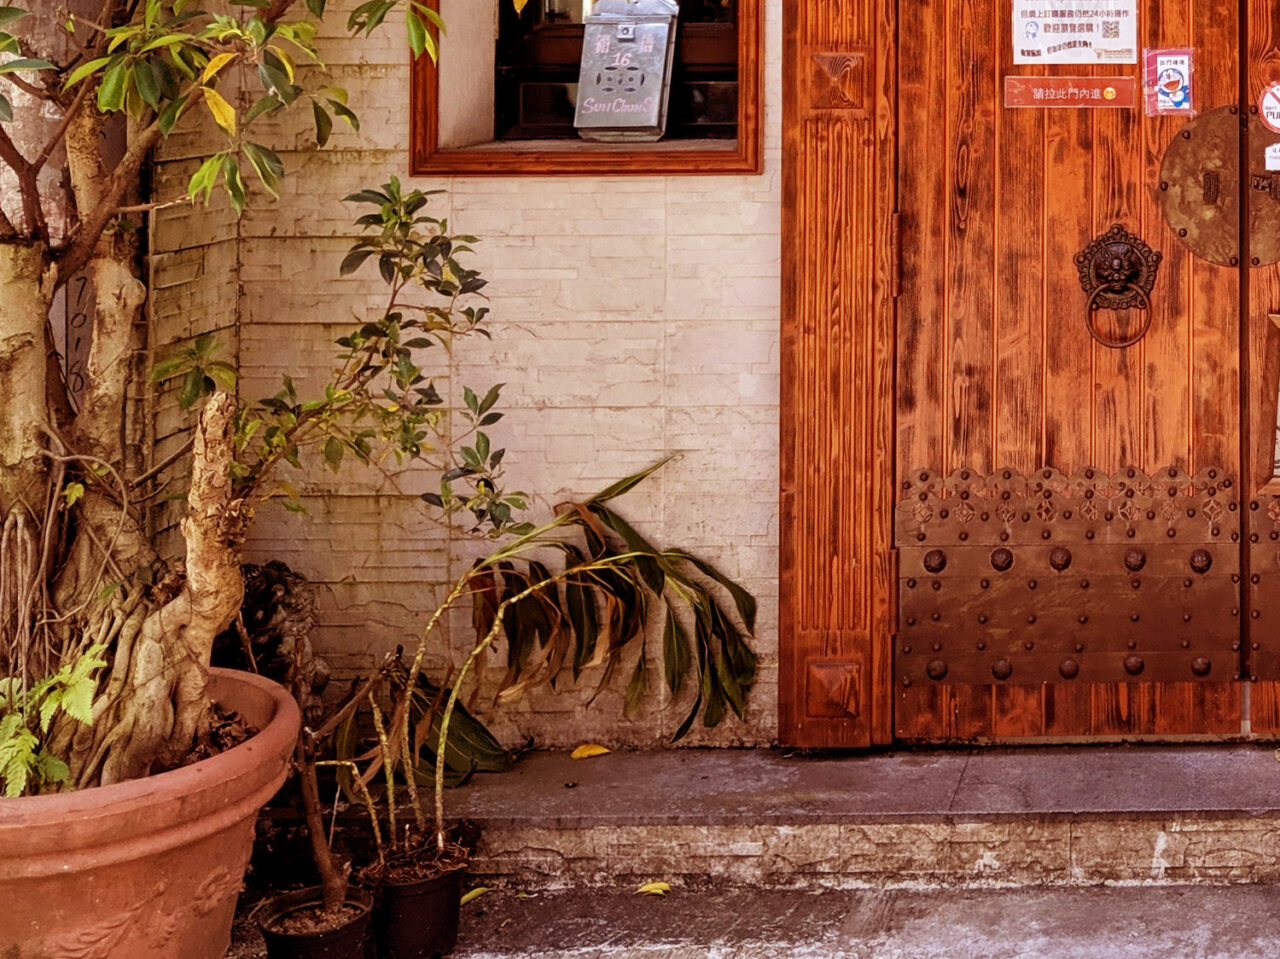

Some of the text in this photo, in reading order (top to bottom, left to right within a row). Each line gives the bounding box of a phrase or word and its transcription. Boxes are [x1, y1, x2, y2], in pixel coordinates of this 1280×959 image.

[611, 52, 633, 66] 16
[1033, 87, 1101, 100] 請拉此門內進
